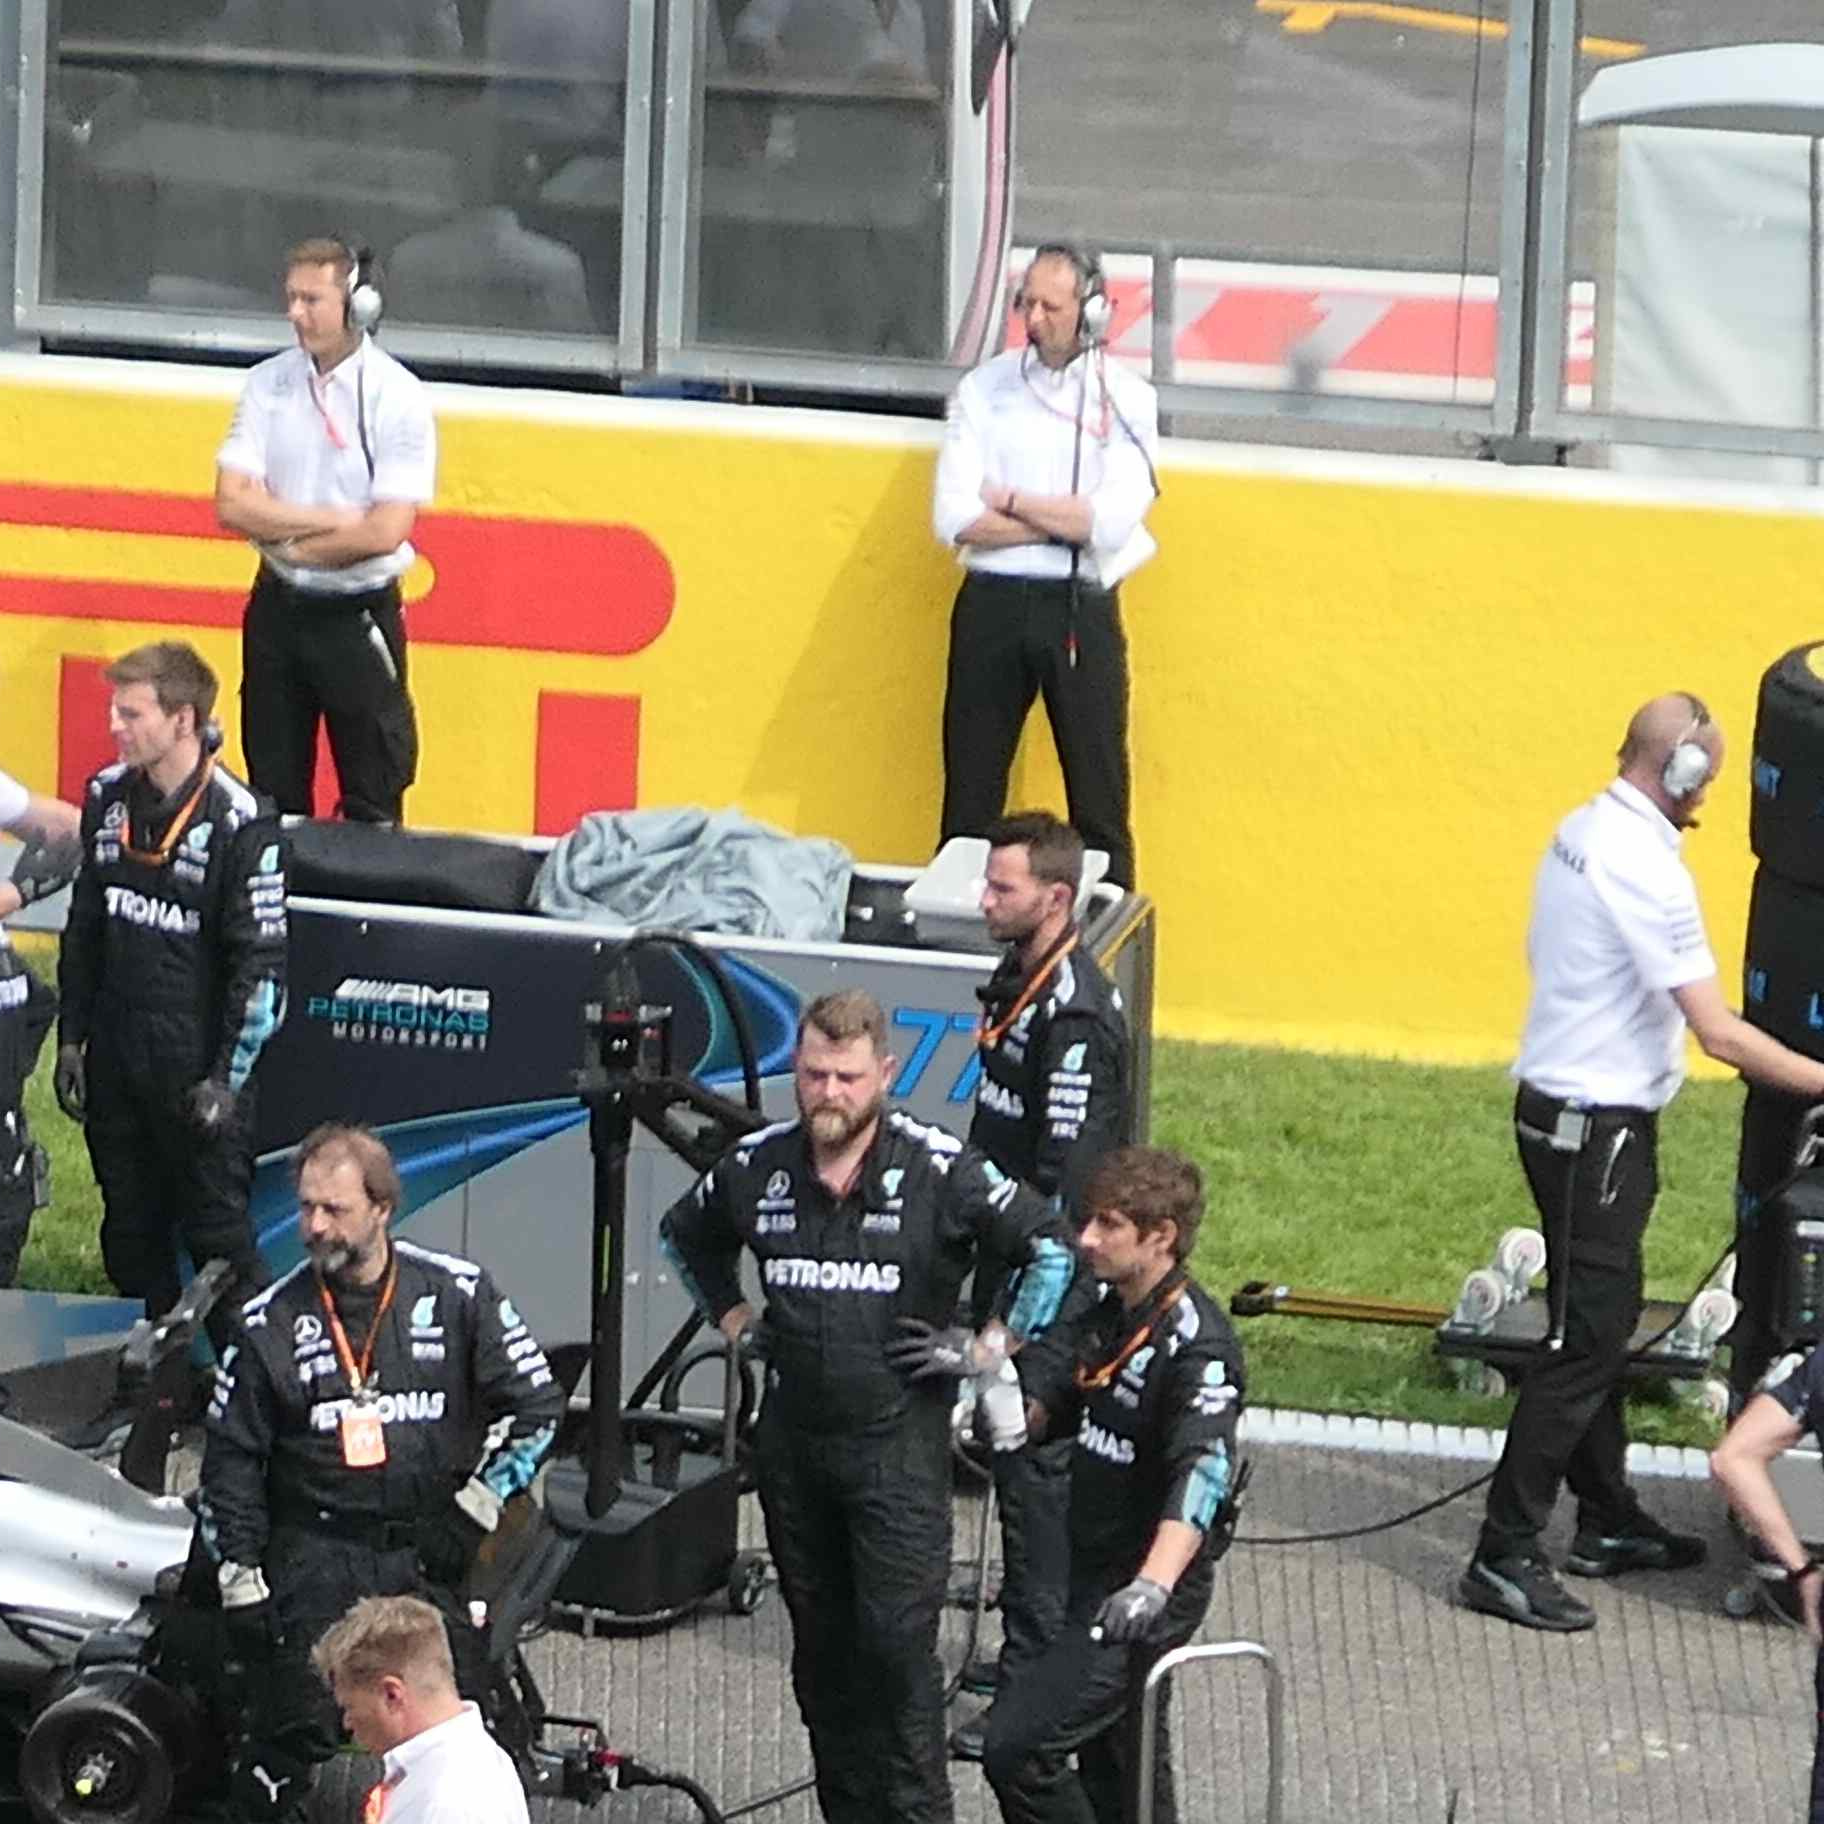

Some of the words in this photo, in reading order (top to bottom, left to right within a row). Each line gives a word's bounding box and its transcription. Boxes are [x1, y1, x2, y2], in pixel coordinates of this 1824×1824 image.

[104, 886, 202, 933] TRONAS
[308, 997, 490, 1033] PETRONAS
[332, 1021, 488, 1052] MOTORSPORT
[765, 1257, 901, 1293] PETRONAS
[310, 1392, 446, 1429] PETONAS
